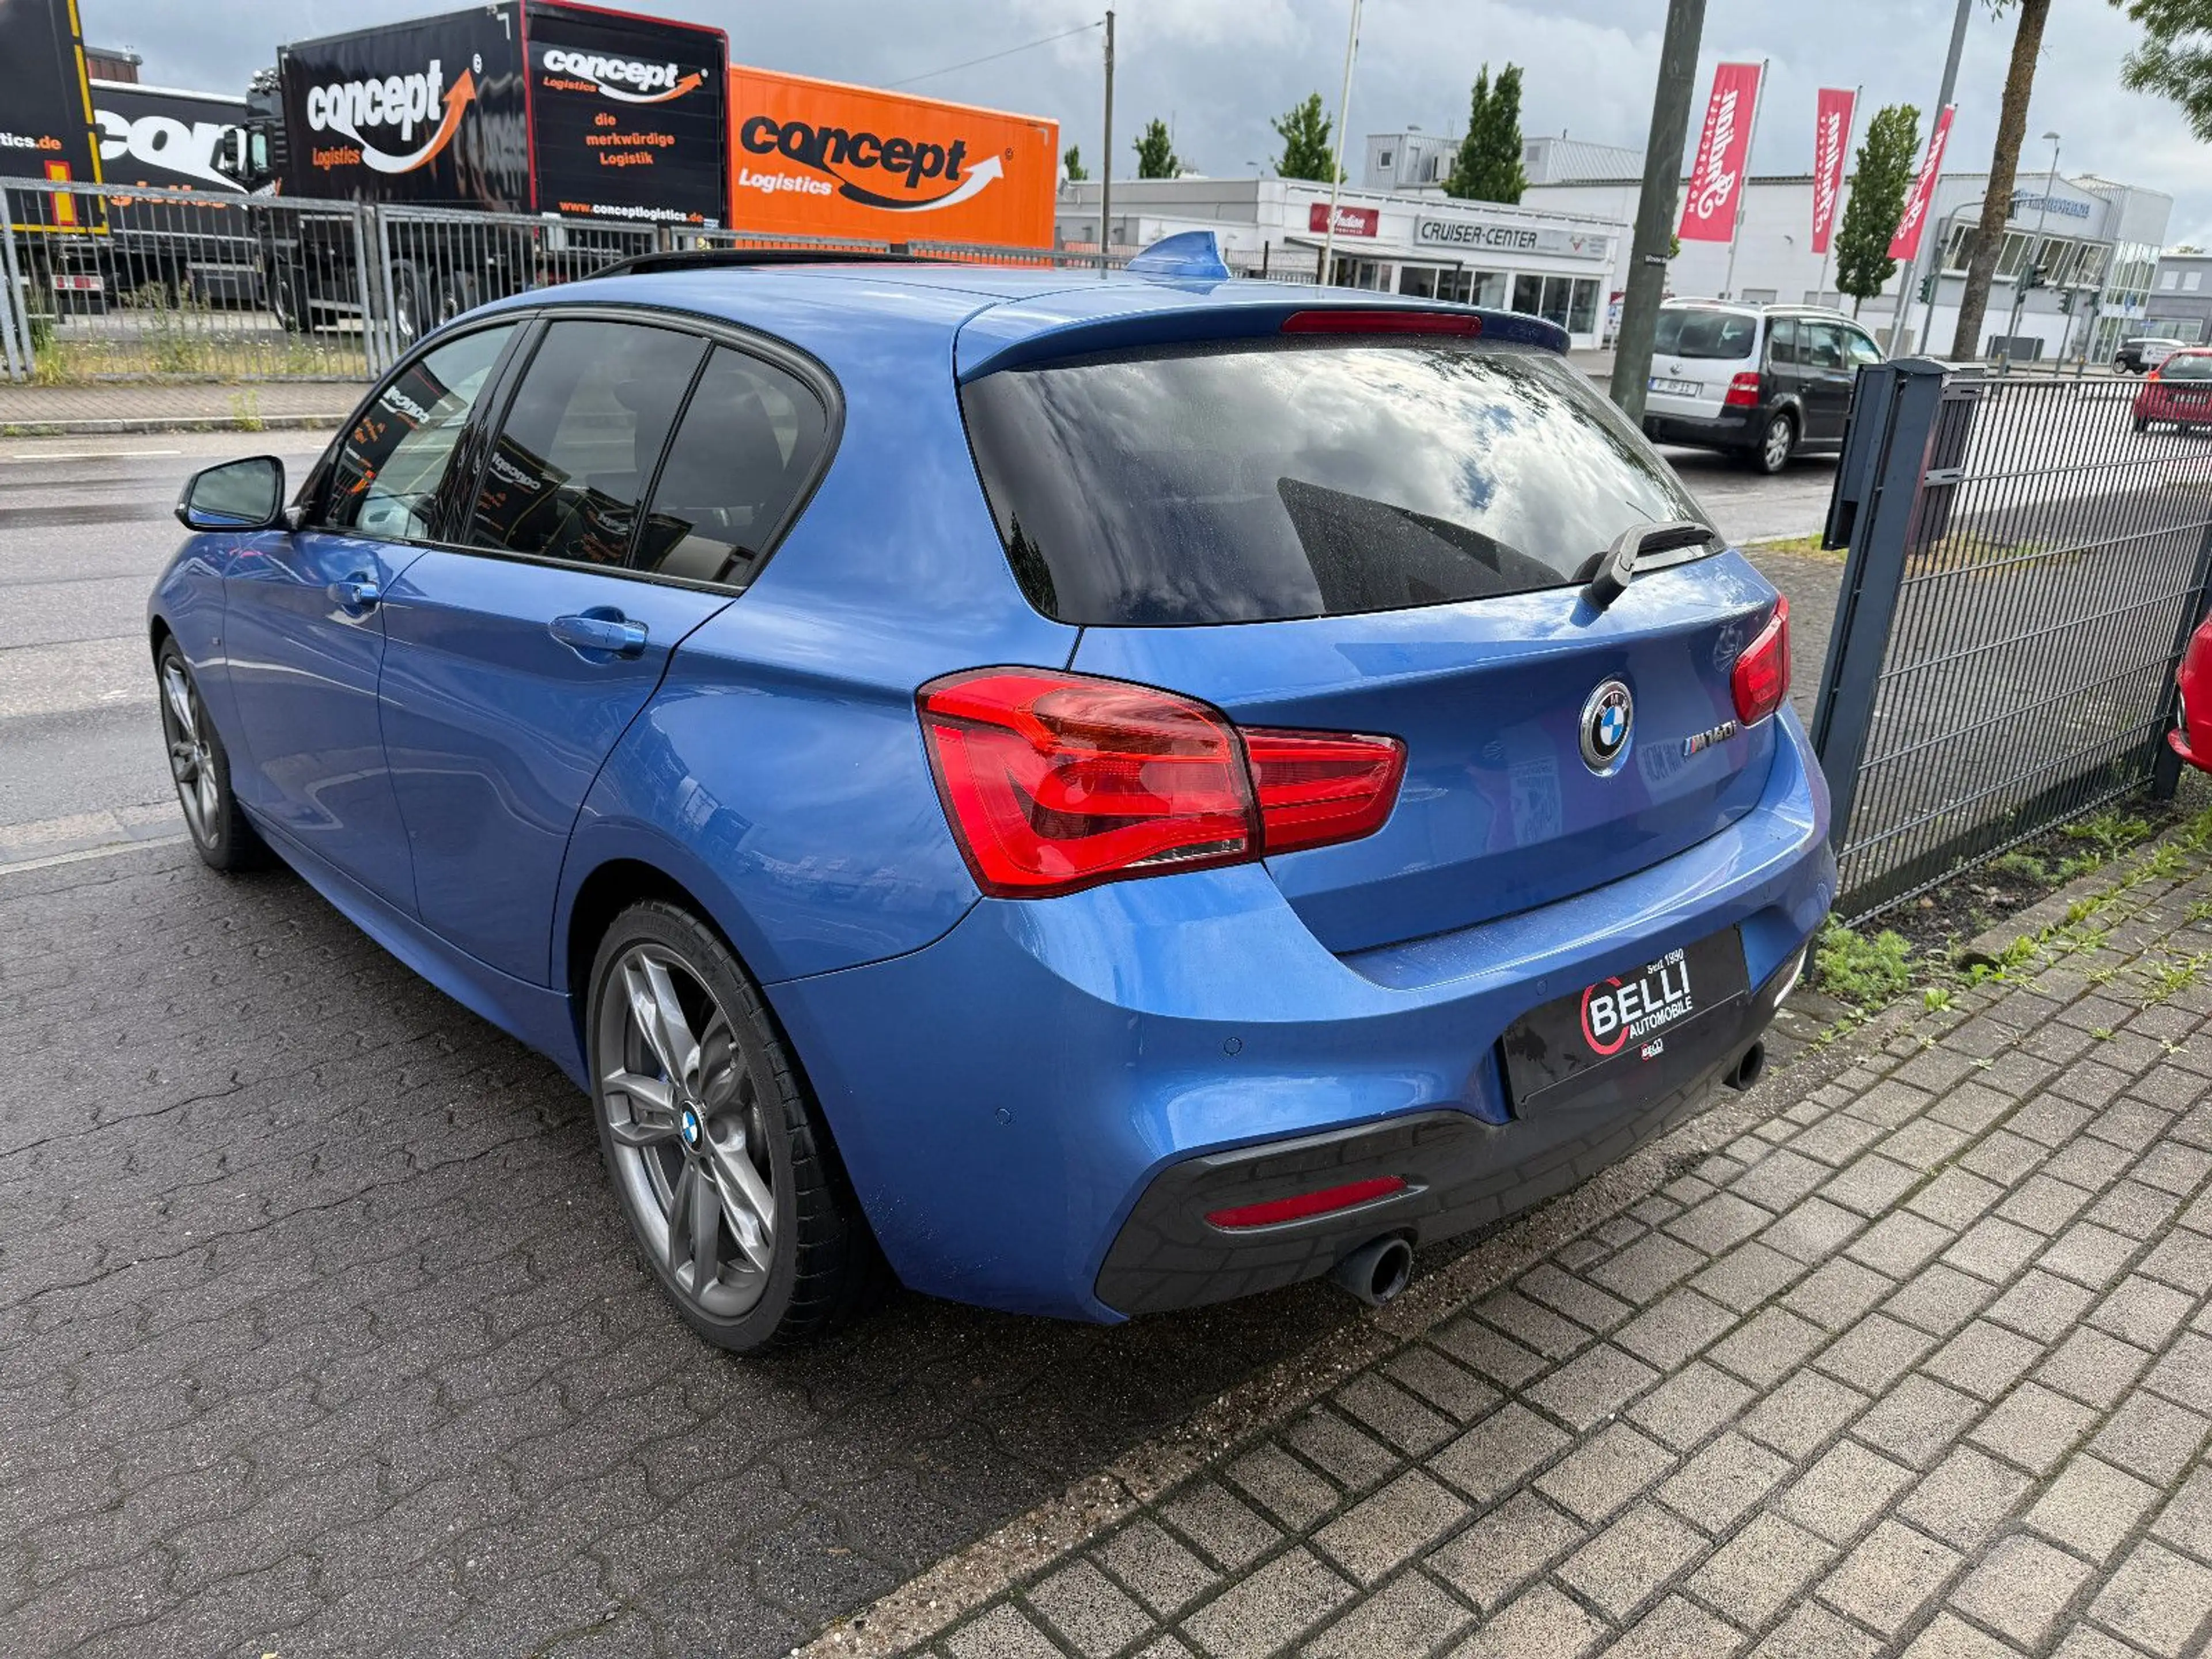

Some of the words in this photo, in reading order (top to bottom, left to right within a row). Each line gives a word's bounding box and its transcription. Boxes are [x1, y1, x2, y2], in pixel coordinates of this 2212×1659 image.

[543, 50, 678, 91] concept
[543, 77, 597, 93] Logistics
[307, 59, 442, 141] concept
[594, 112, 616, 126] die
[585, 132, 675, 147] merkwürdige
[740, 116, 966, 189] concept
[312, 145, 361, 171] Logistics
[599, 151, 653, 166] Logistik
[739, 168, 832, 195] Logistics
[558, 202, 704, 223] www.conceptlogistics.de
[1421, 222, 1537, 249] CRUISER-CENTER
[1590, 959, 1690, 1037] BELLI
[1630, 995, 1693, 1039] AUTOMOBILE
